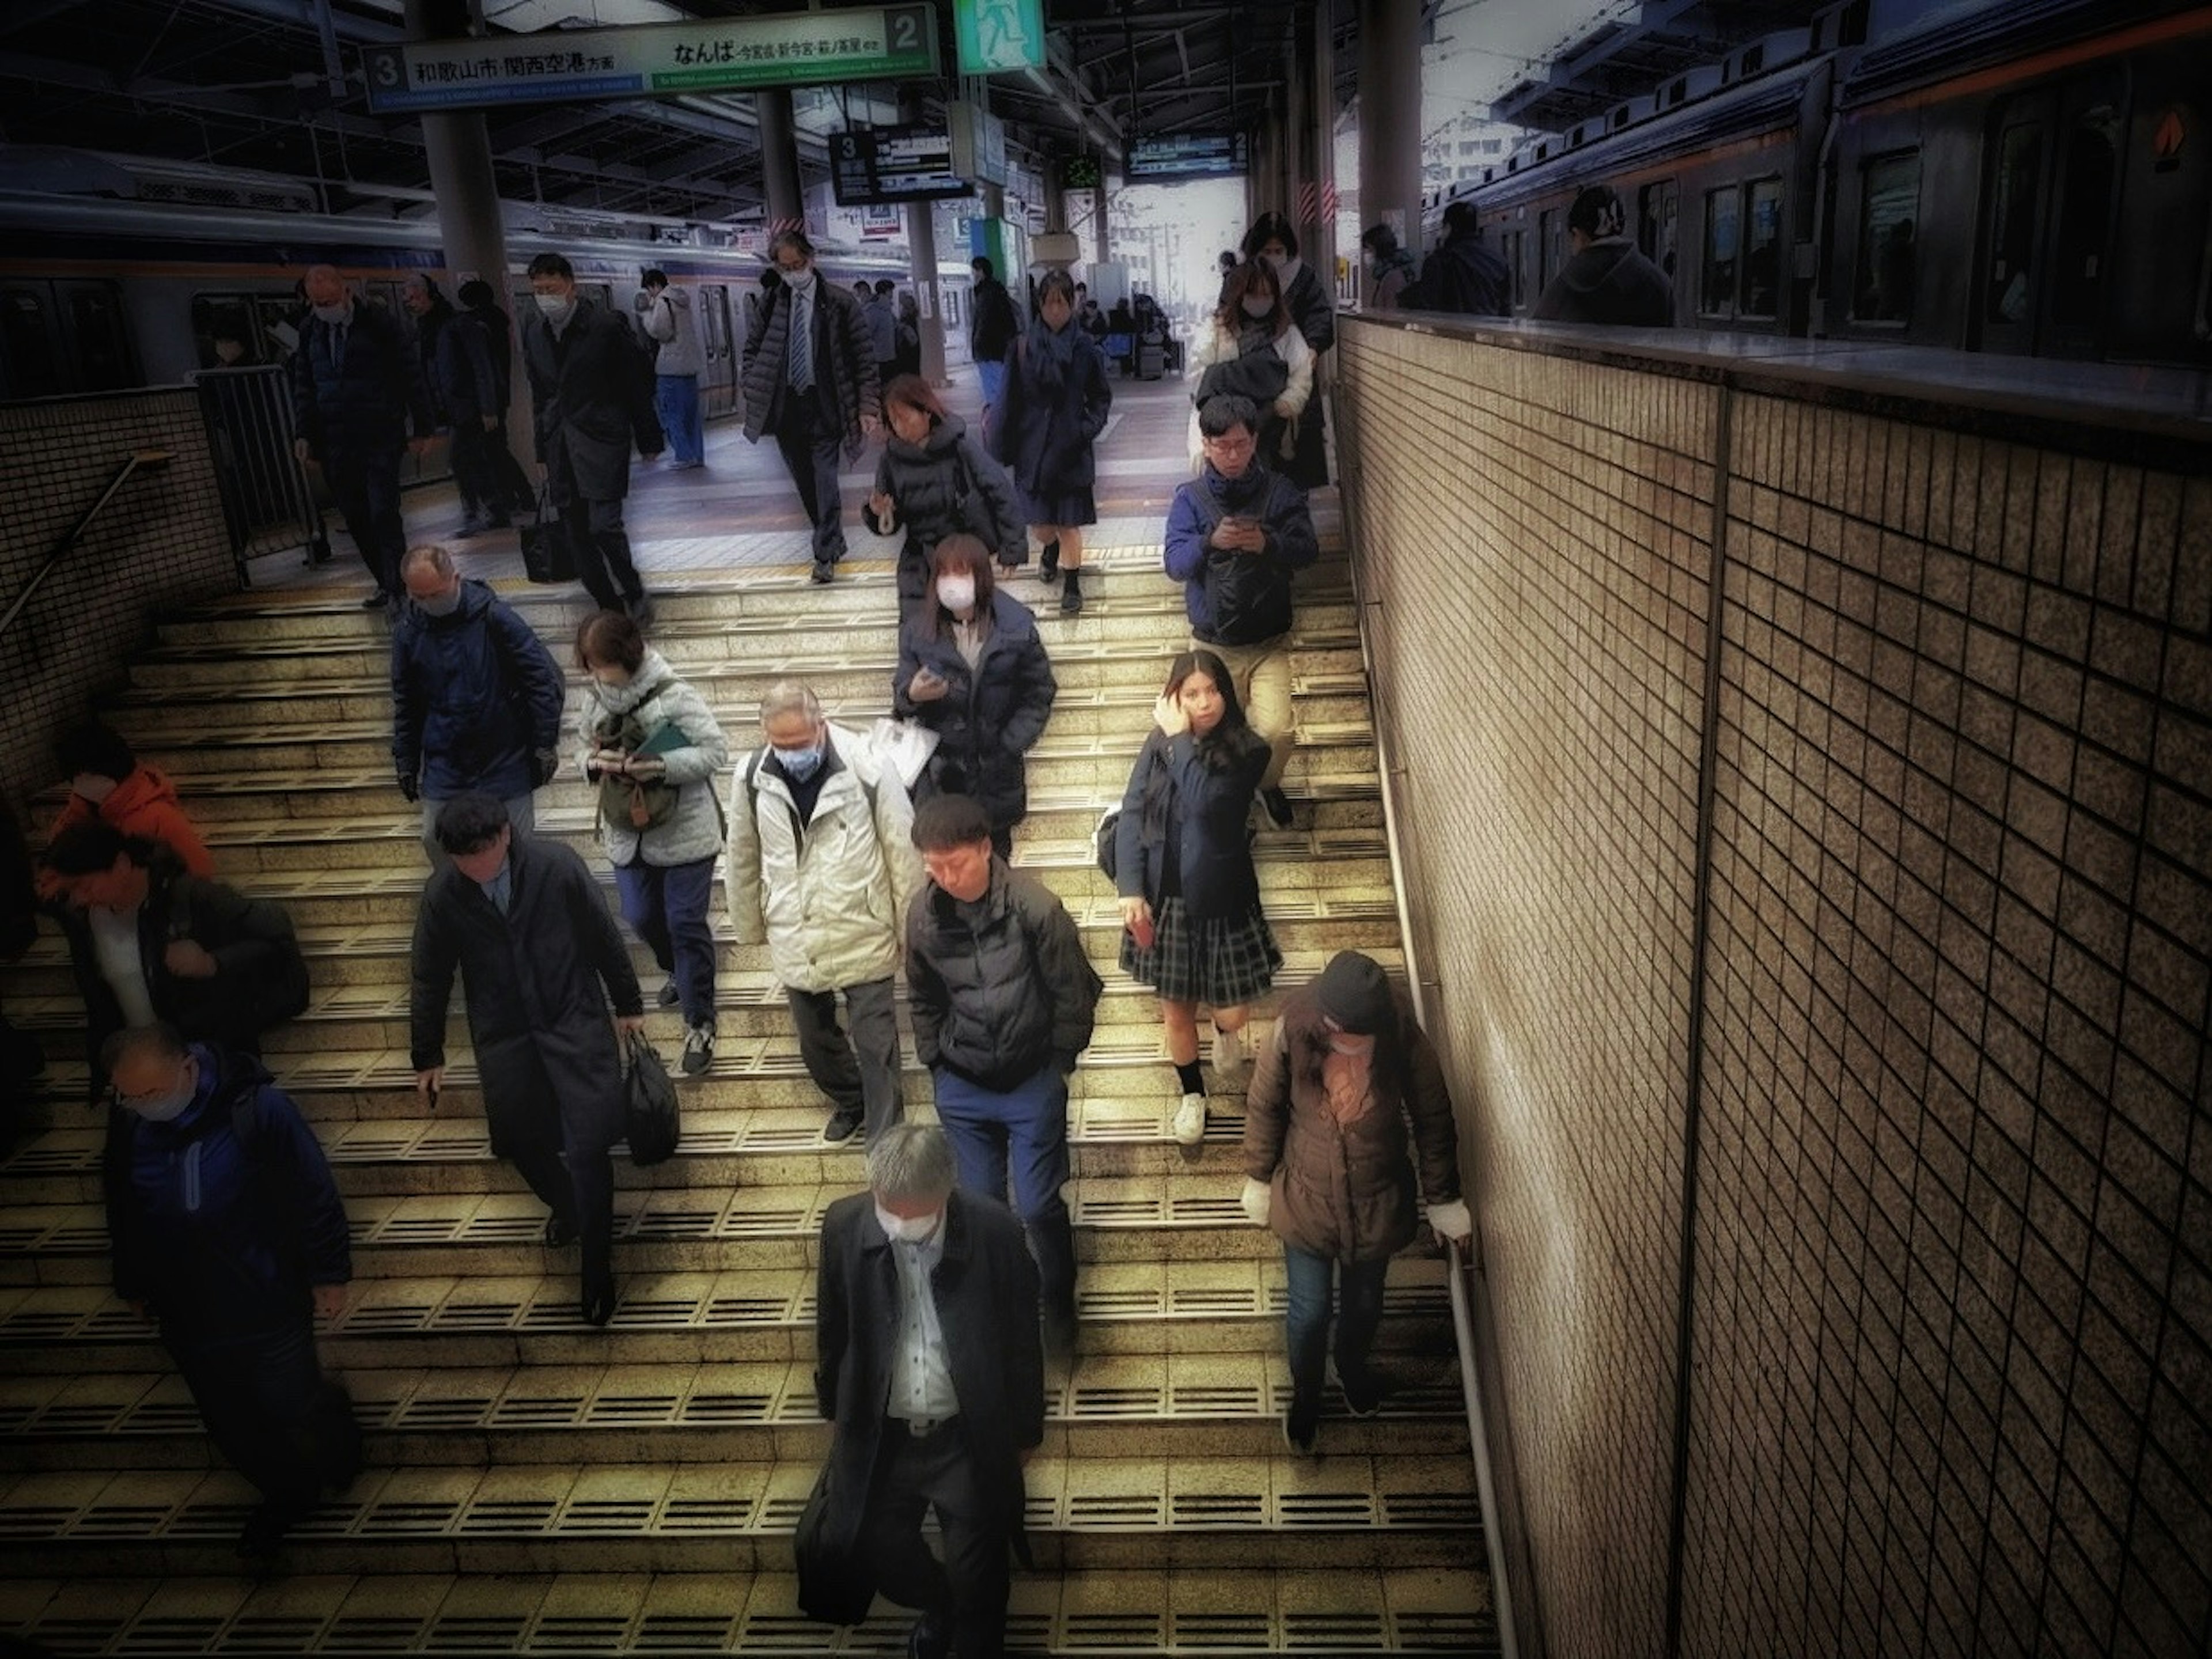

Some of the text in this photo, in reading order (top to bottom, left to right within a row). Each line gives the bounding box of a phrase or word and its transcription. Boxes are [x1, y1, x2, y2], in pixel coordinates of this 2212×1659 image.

[895, 16, 918, 48] 2
[374, 54, 399, 86] 3
[841, 136, 857, 158] 3
